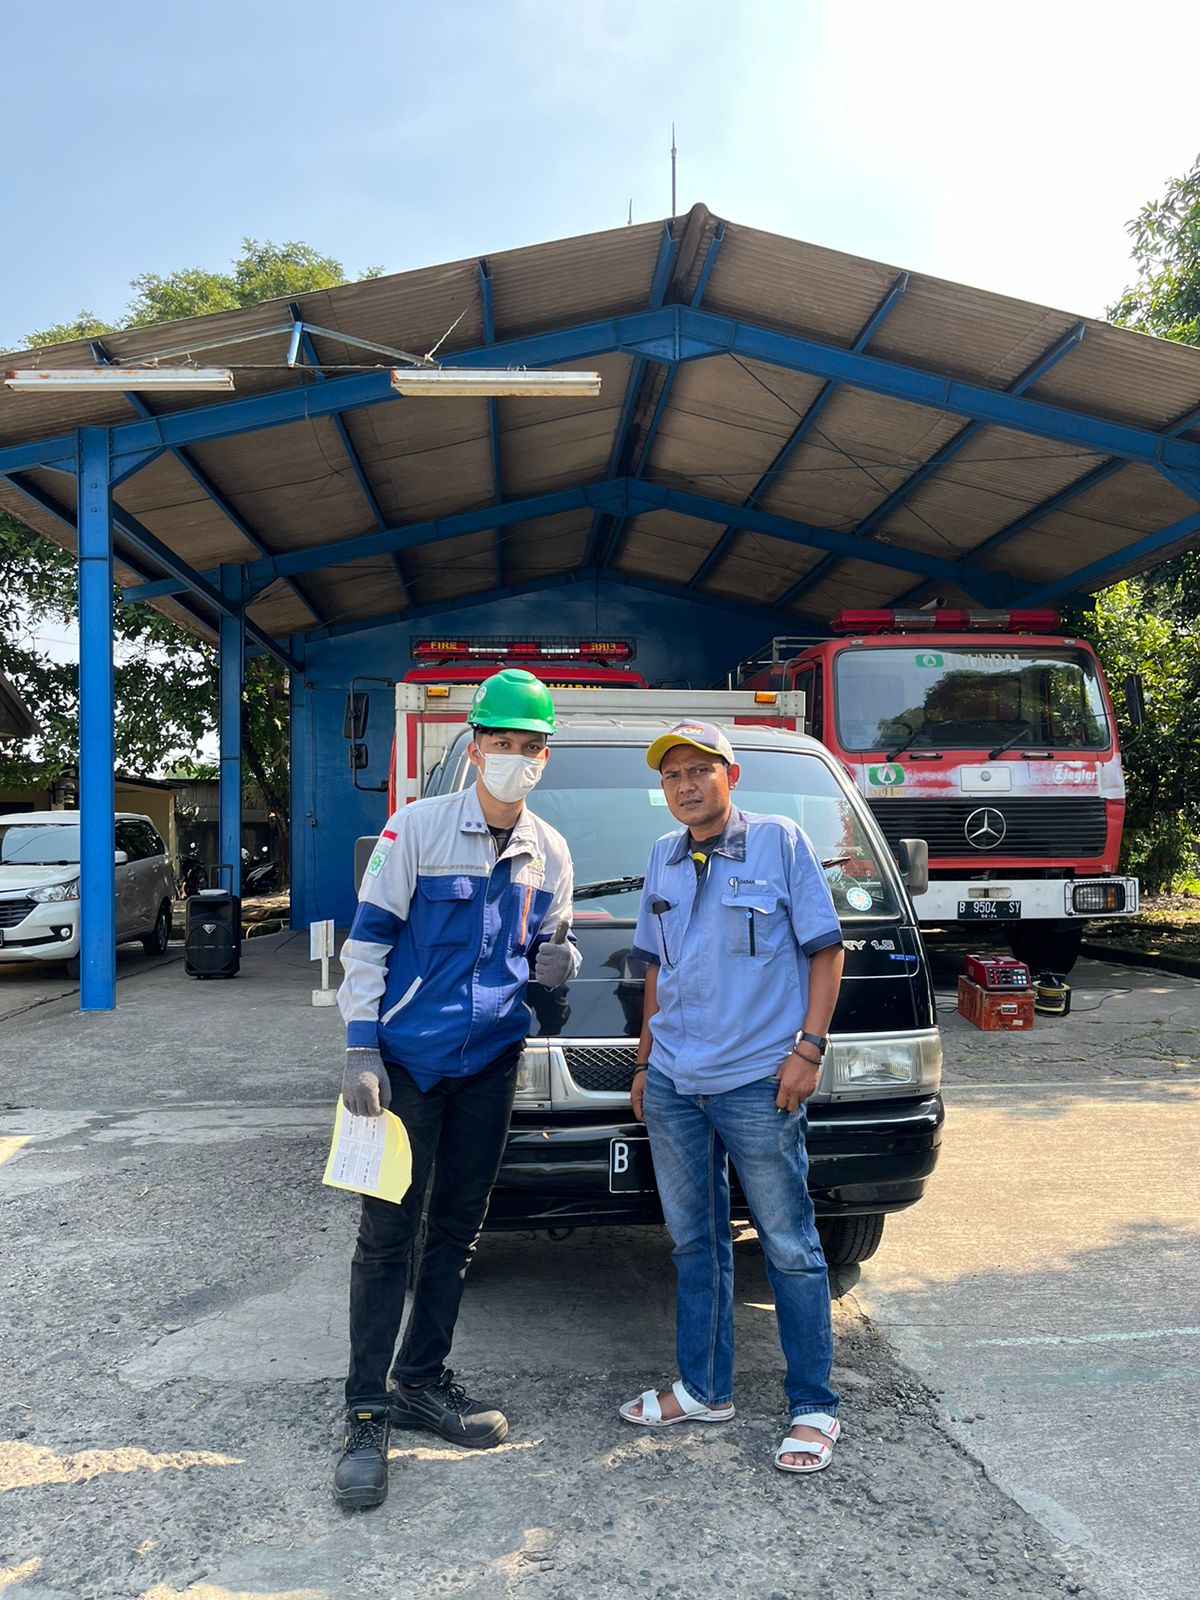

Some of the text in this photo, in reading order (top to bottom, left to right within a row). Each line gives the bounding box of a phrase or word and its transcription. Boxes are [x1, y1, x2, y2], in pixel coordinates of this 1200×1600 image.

[430, 641, 457, 650] FIRE
[1053, 763, 1098, 784] Ziegler
[959, 901, 1021, 913] B 9504 SY
[614, 1142, 629, 1173] B
